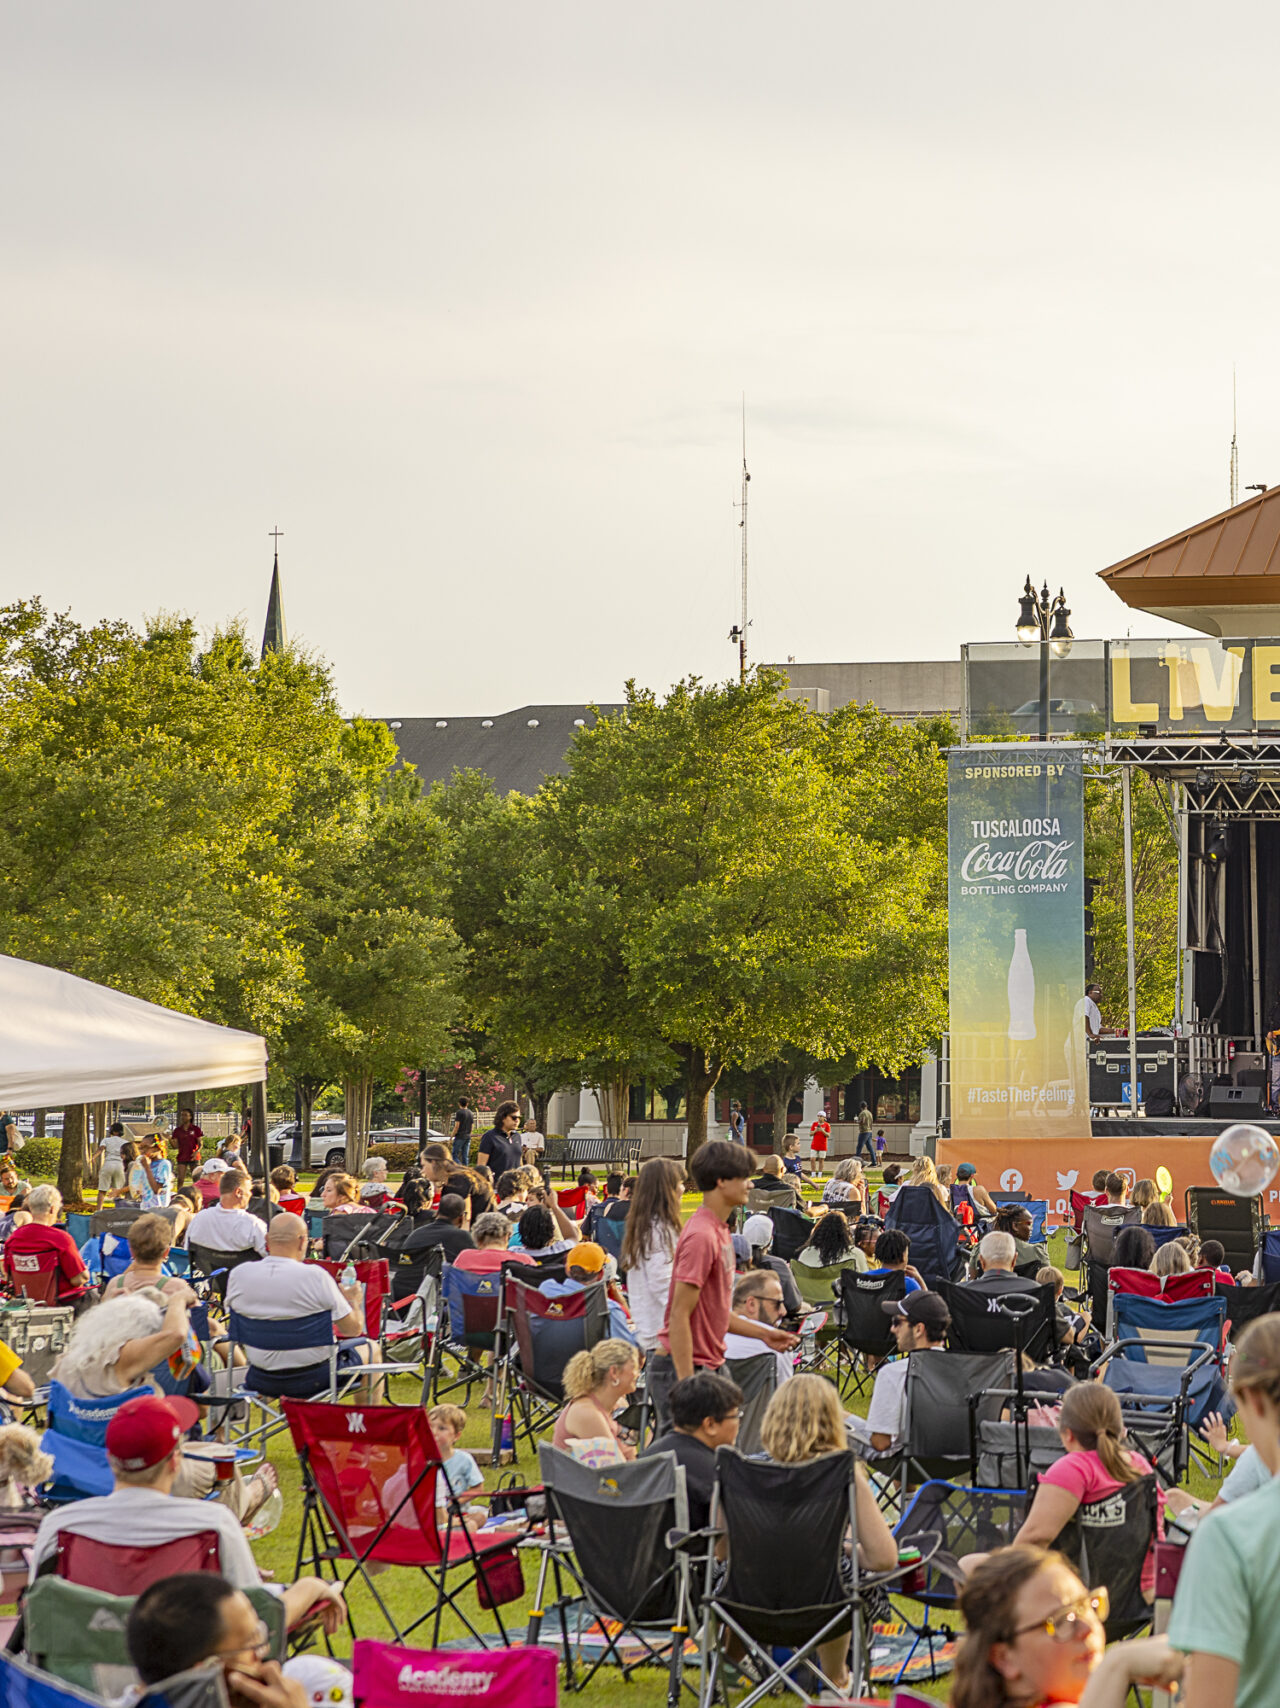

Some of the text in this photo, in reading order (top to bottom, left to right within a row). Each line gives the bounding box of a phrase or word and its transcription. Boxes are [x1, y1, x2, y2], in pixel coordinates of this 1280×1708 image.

[965, 765, 1065, 779] SPONSORED BY
[971, 818, 1061, 838] TUSCALOOSA
[961, 883, 1069, 896] BOTTLING COMPANY
[968, 1085, 1075, 1104] #TasteTheFeeling
